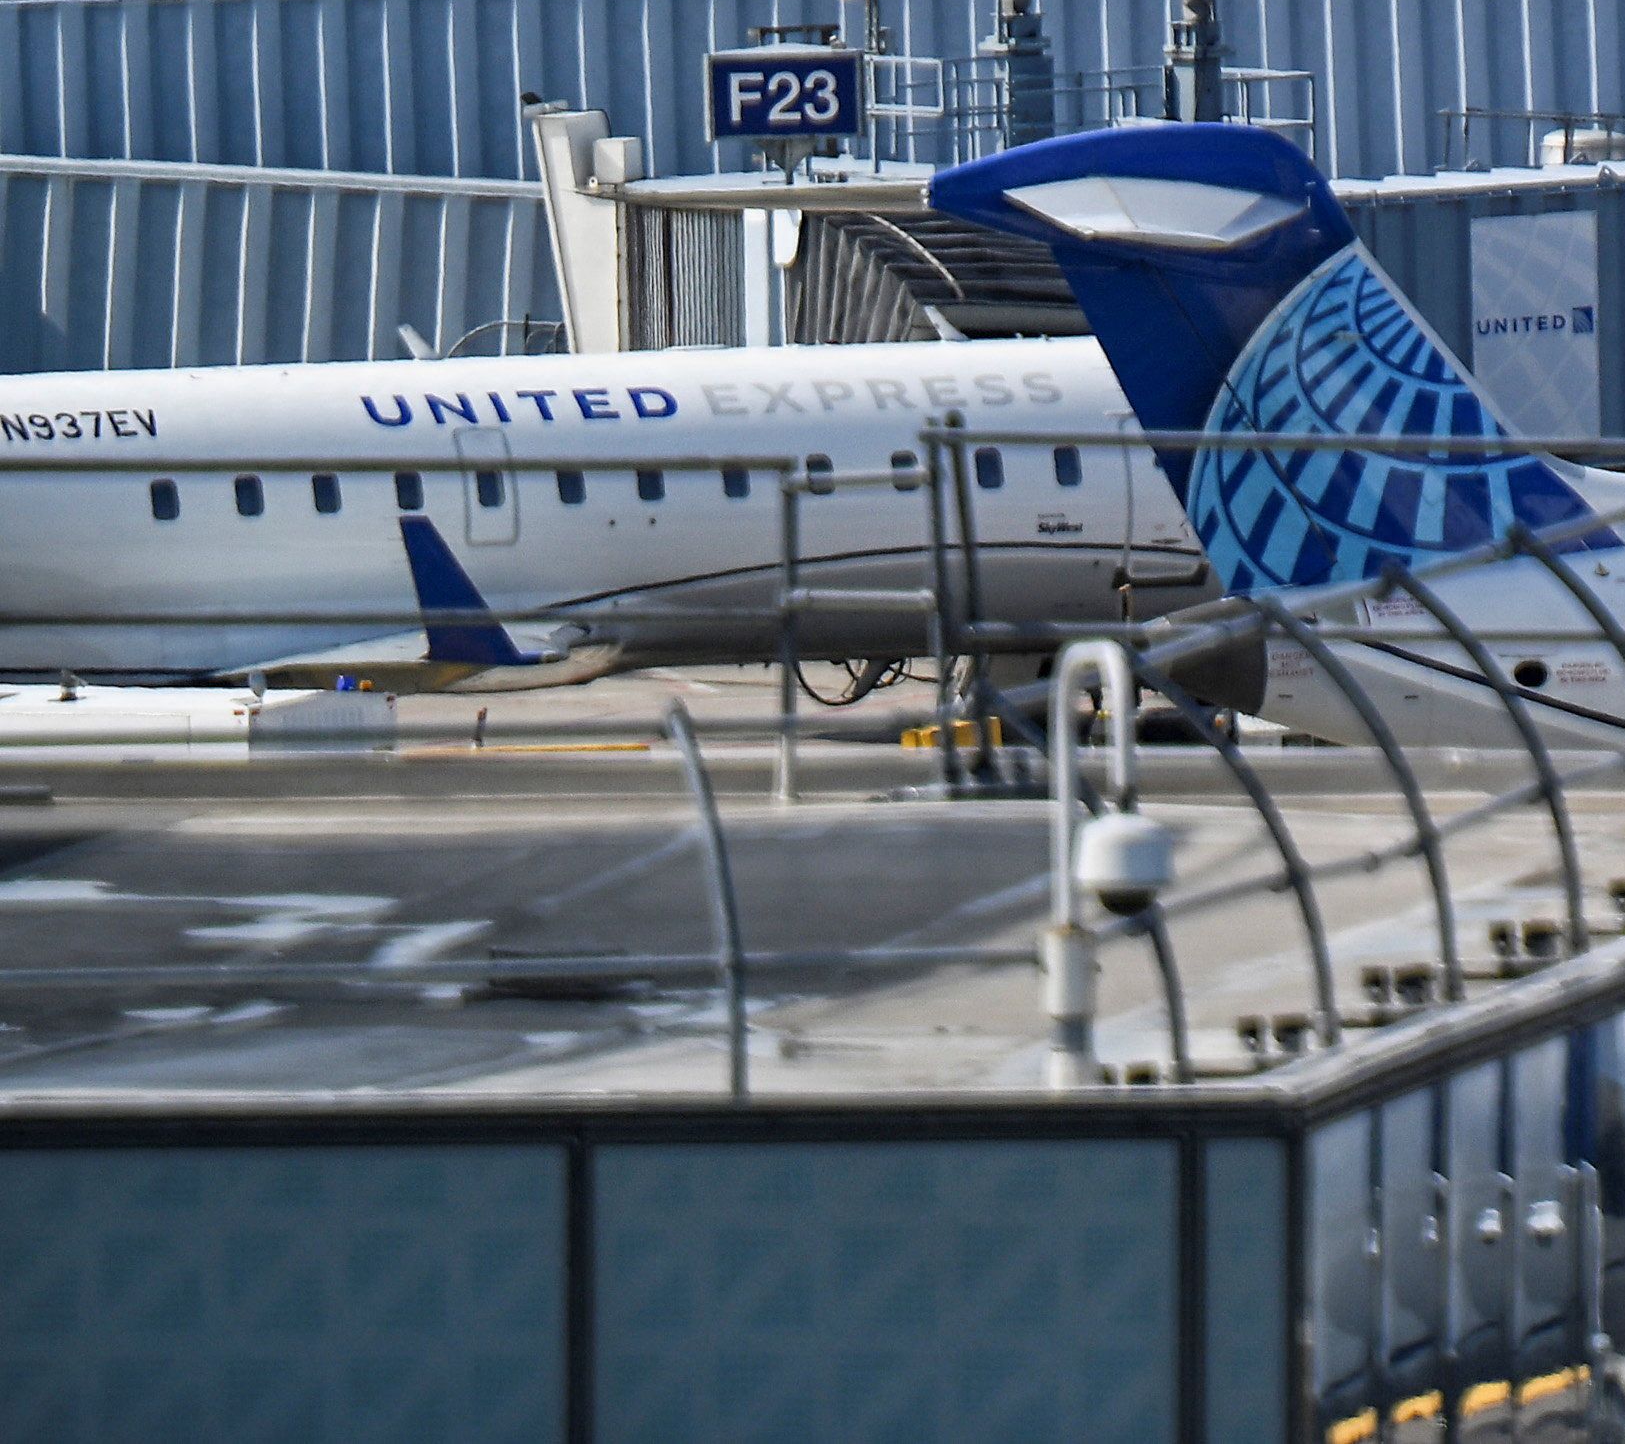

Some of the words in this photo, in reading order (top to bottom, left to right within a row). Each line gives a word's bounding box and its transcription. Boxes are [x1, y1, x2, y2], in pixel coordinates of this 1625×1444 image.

[729, 68, 840, 122] F23
[1477, 314, 1567, 335] UNITED
[360, 387, 680, 427] UNITED
[700, 372, 1064, 415] EXPRESS
[0, 409, 158, 441] N937EV
